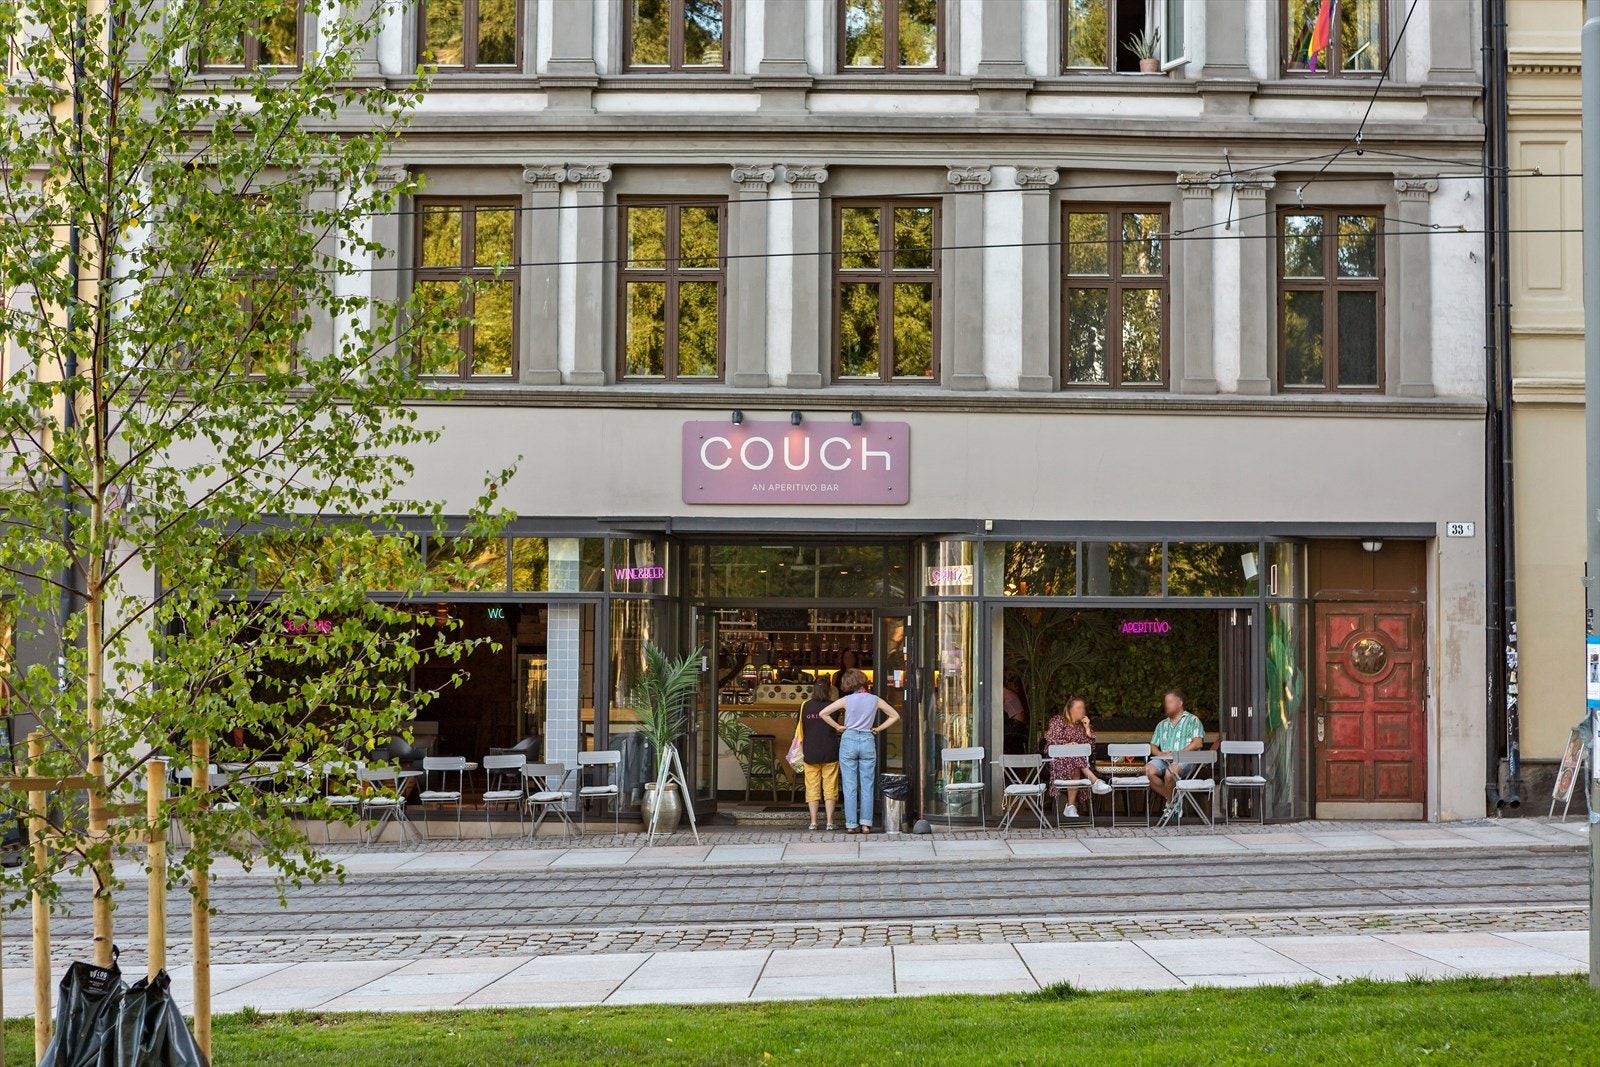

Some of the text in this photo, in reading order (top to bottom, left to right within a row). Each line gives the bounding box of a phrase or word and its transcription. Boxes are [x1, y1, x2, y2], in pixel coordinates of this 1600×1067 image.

[751, 484, 840, 492] AN APERITIVO BAR
[1452, 524, 1464, 535] 33
[487, 608, 505, 619] WC
[1121, 621, 1169, 634] APERITIVO
